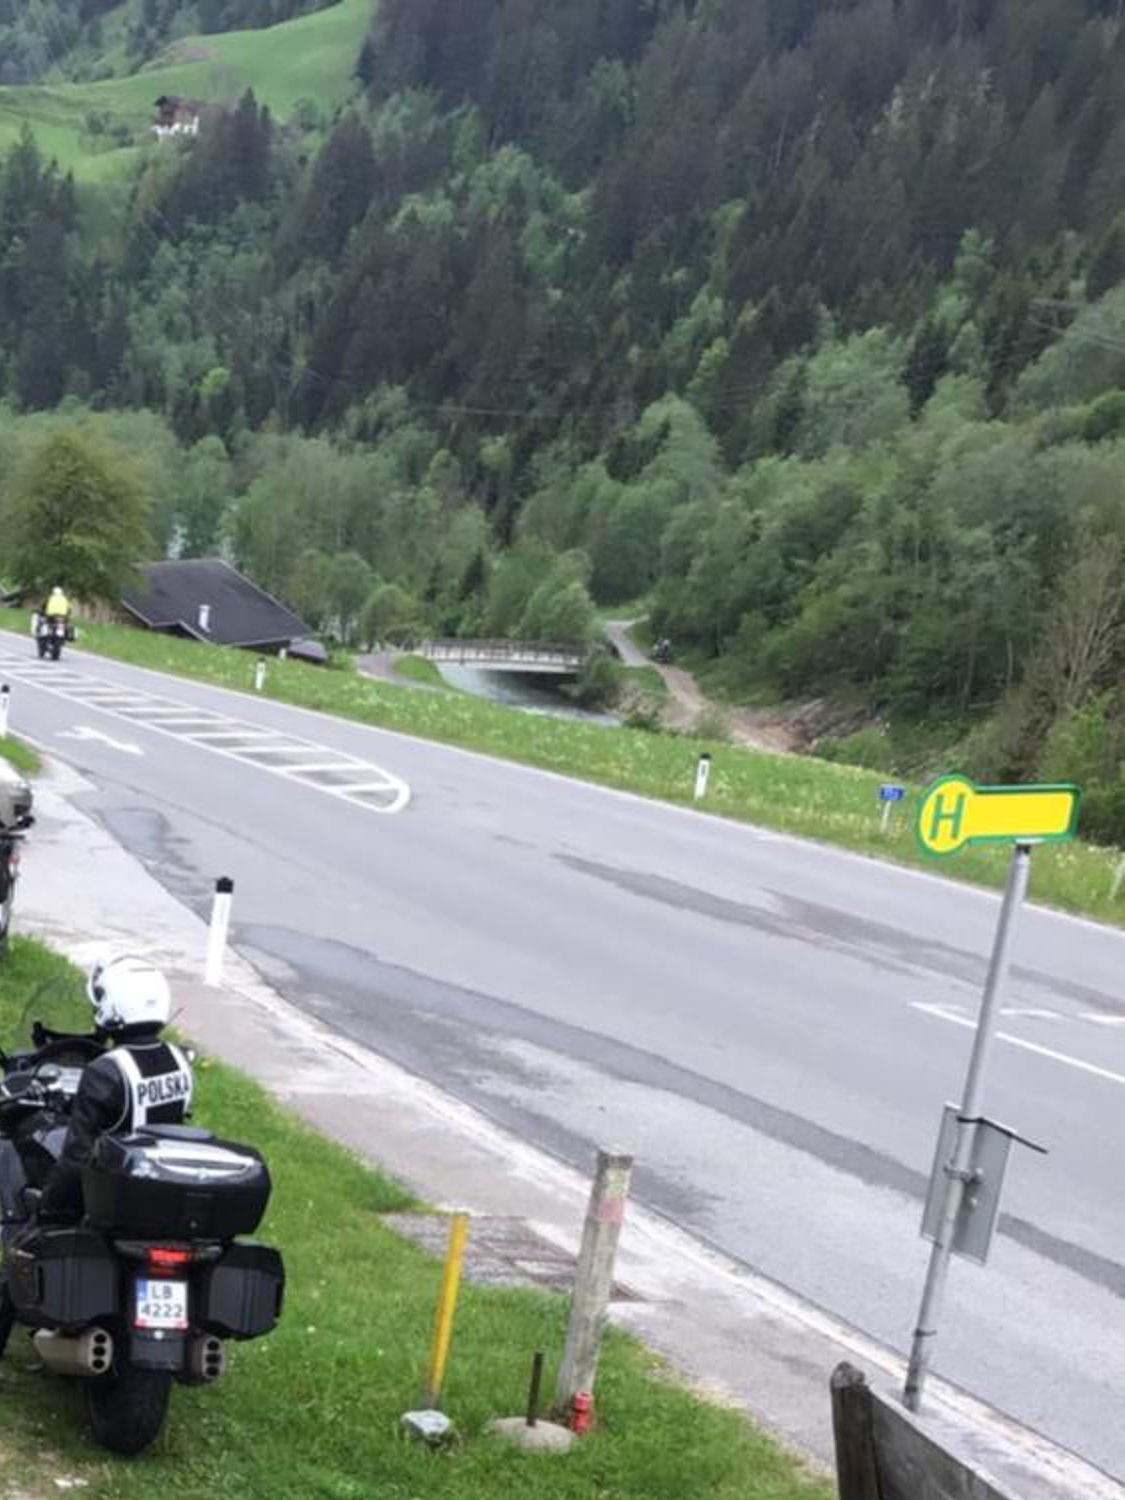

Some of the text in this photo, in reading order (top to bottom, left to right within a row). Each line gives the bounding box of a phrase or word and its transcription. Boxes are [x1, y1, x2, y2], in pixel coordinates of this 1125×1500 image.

[929, 792, 966, 841] H
[136, 1073, 189, 1106] POLSKA
[151, 1285, 174, 1300] LB
[140, 1303, 184, 1318] 4222
